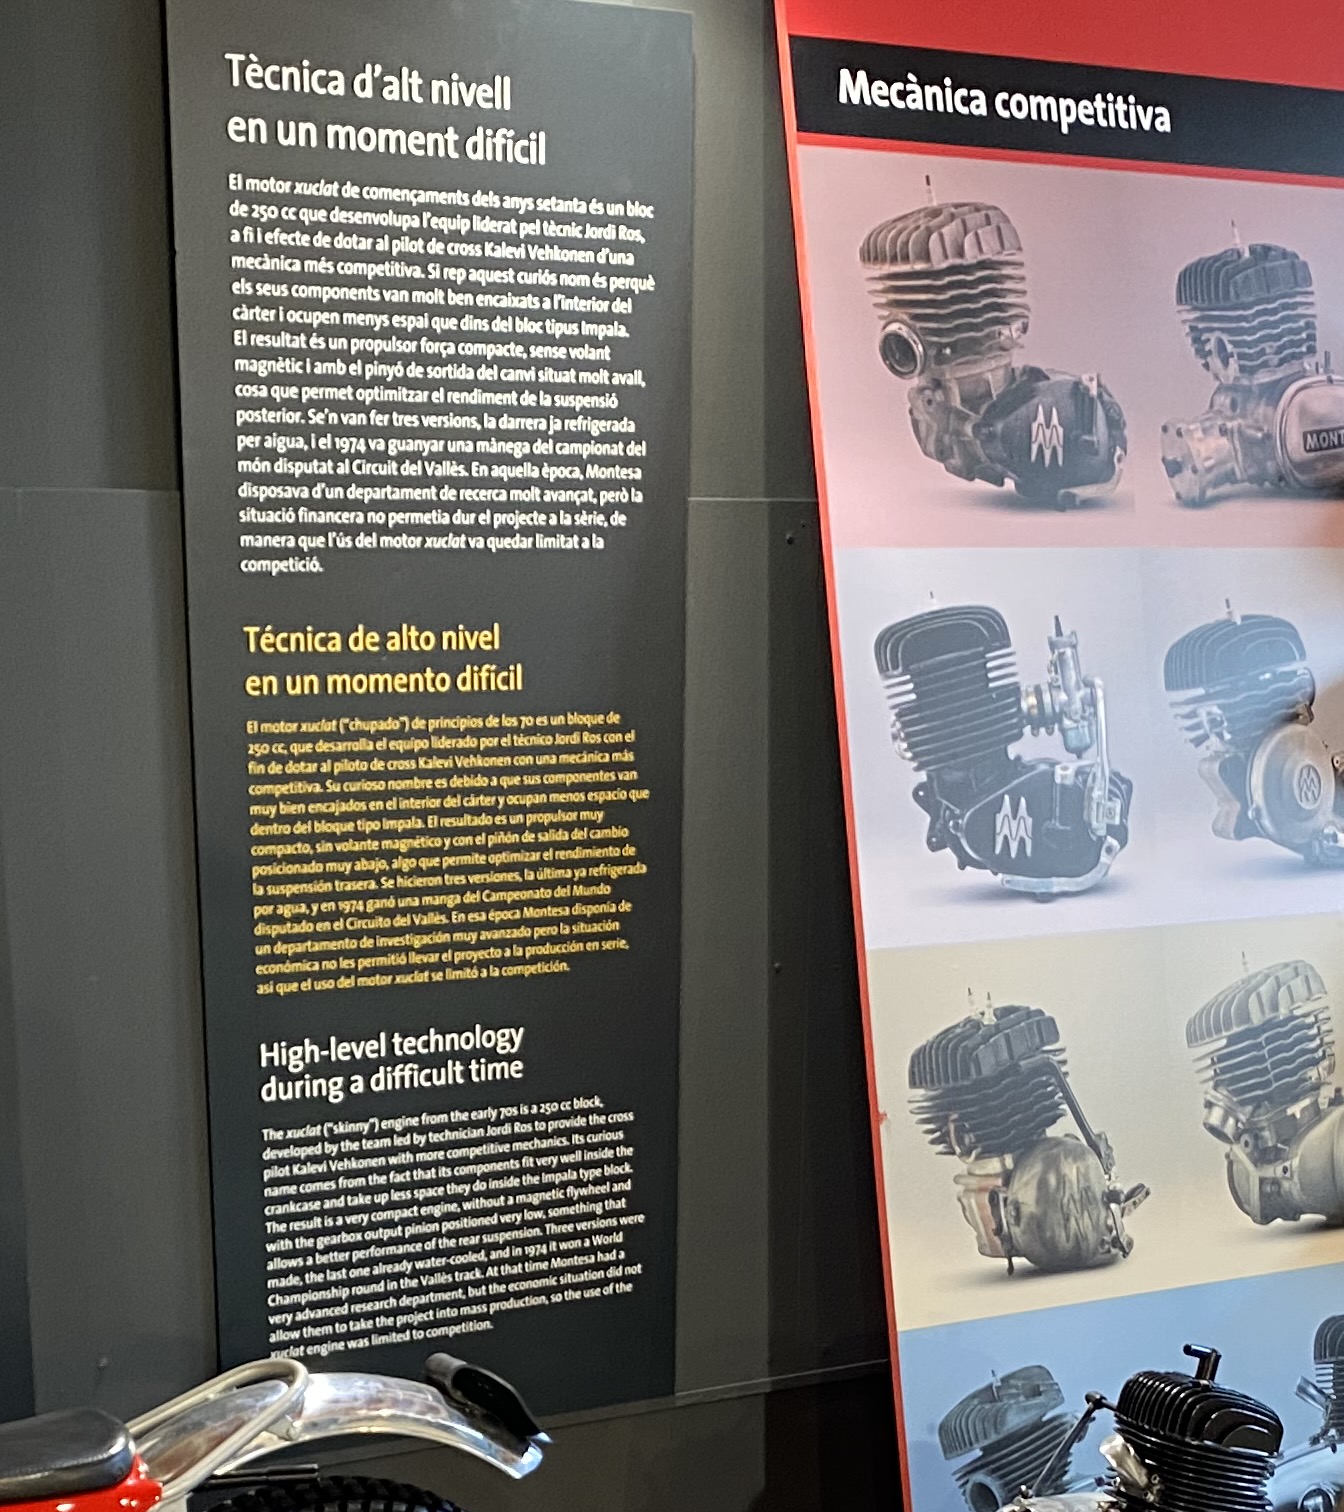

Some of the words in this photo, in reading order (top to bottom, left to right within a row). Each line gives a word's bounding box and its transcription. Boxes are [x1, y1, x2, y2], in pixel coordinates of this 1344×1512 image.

[224, 52, 346, 97] Tècnica
[431, 71, 512, 112] nivell
[838, 67, 988, 117] Mecànica
[994, 91, 1172, 135] competitiva
[227, 115, 268, 144] en
[277, 119, 318, 148] un
[326, 123, 460, 160] moment
[465, 124, 546, 167] difícil
[228, 172, 243, 191] El
[245, 175, 293, 195] motor
[293, 178, 340, 198] xuclat
[341, 180, 361, 199] de
[361, 185, 471, 208] començaments
[471, 188, 502, 209] dels
[501, 194, 535, 216] anys
[535, 194, 588, 215] setanta
[588, 197, 605, 216] és
[605, 202, 625, 217] un
[626, 199, 655, 220] bloc
[242, 623, 342, 654] Técnica
[348, 622, 381, 653] de
[386, 622, 436, 652] alto
[442, 622, 500, 651] nivel
[245, 674, 278, 697] en
[285, 674, 320, 696] un
[326, 666, 452, 695] momento
[456, 662, 523, 692] difícil
[260, 1031, 388, 1072] High-level
[391, 1022, 525, 1057] technology
[260, 1073, 345, 1105] during
[349, 1073, 365, 1094] a
[369, 1059, 466, 1093] difficult
[468, 1057, 524, 1083] time
[263, 1163, 291, 1183] pilot
[291, 1159, 328, 1176] Kalevi
[328, 1155, 387, 1173] Vehkonen
[387, 1149, 415, 1166] with
[415, 1149, 446, 1163] more
[445, 1141, 511, 1160] competitive
[511, 1135, 571, 1152] mechanics.
[571, 1132, 586, 1145] Its
[586, 1129, 625, 1144] curious
